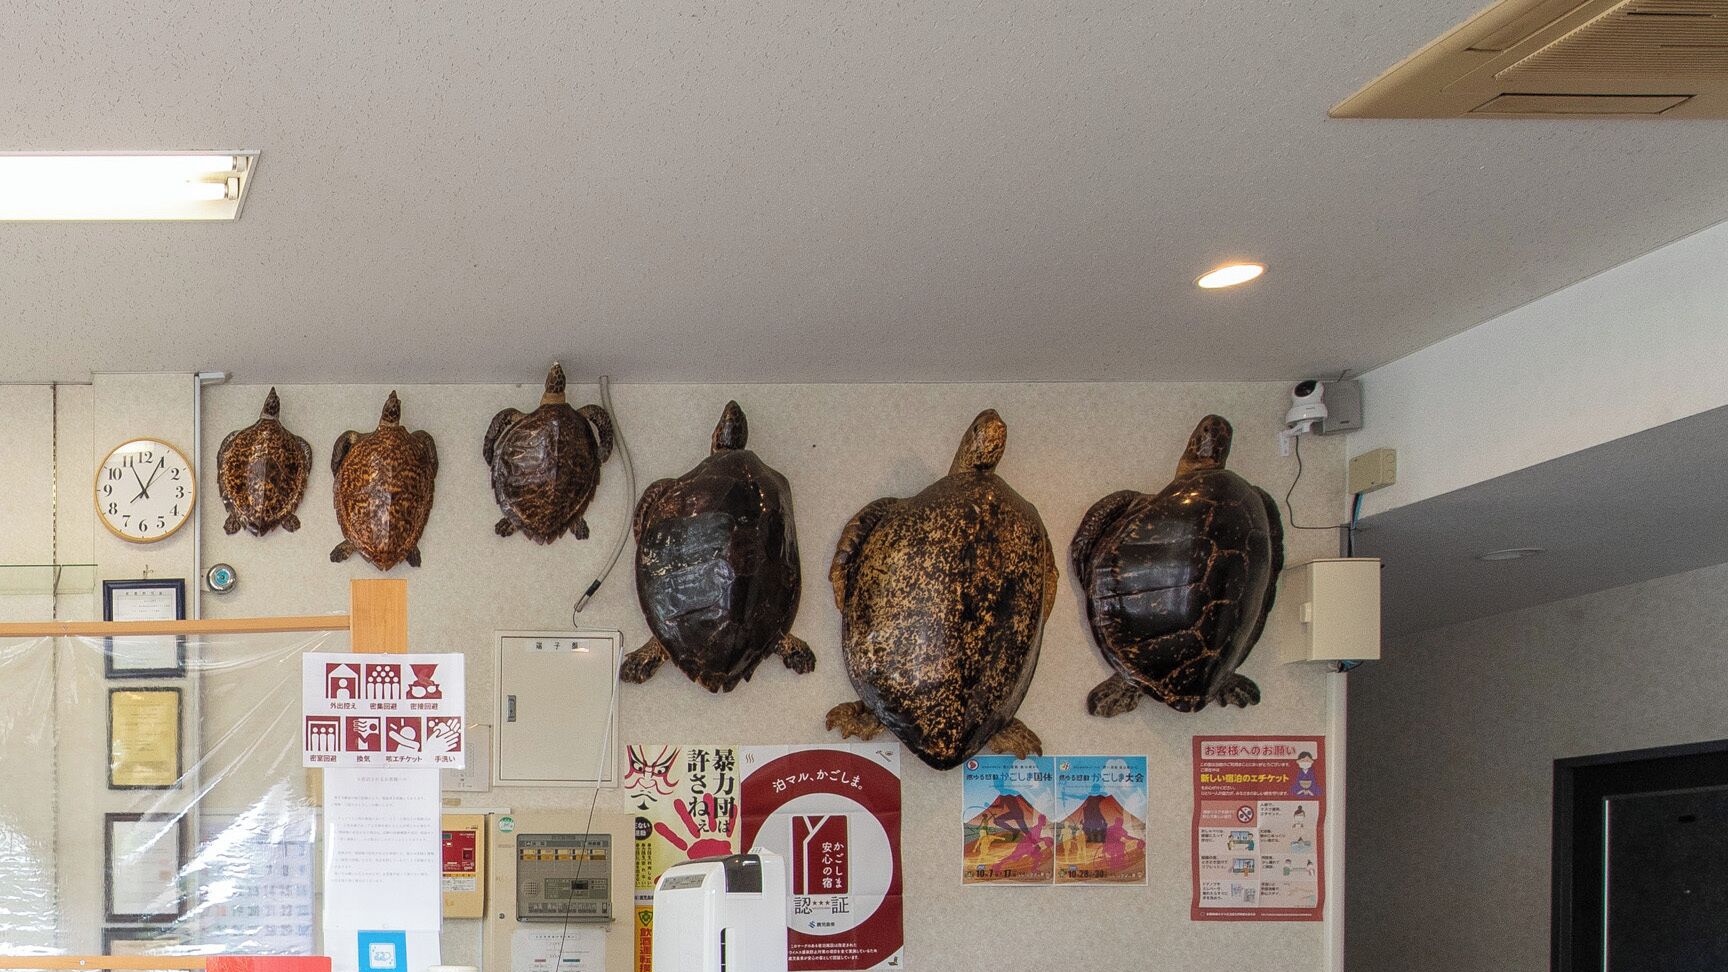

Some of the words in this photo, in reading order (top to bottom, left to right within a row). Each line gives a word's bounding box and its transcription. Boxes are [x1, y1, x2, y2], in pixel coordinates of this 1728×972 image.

[122, 456, 134, 468] 11
[138, 451, 153, 464] 12
[108, 467, 122, 481] 10
[170, 467, 180, 481] 2
[103, 484, 113, 497] 9
[175, 486, 185, 499] 3
[108, 502, 118, 515] 8
[169, 504, 179, 516] 4
[122, 515, 131, 527] 7
[138, 519, 148, 532] 6
[156, 516, 166, 529] 5
[330, 702, 357, 710] 外出控え
[370, 702, 398, 710] 密集回避
[410, 702, 438, 710] 密接回避
[1205, 745, 1296, 756] お客様へのお願い
[772, 769, 863, 793] 泊マル、かごしま。
[1200, 774, 1289, 783] 新しい宿泊のエチケット
[712, 748, 735, 833] 暴力団は
[821, 842, 833, 889] 安心の宿
[833, 842, 845, 888] かごしま
[794, 897, 813, 915] 認
[831, 897, 849, 914] 証
